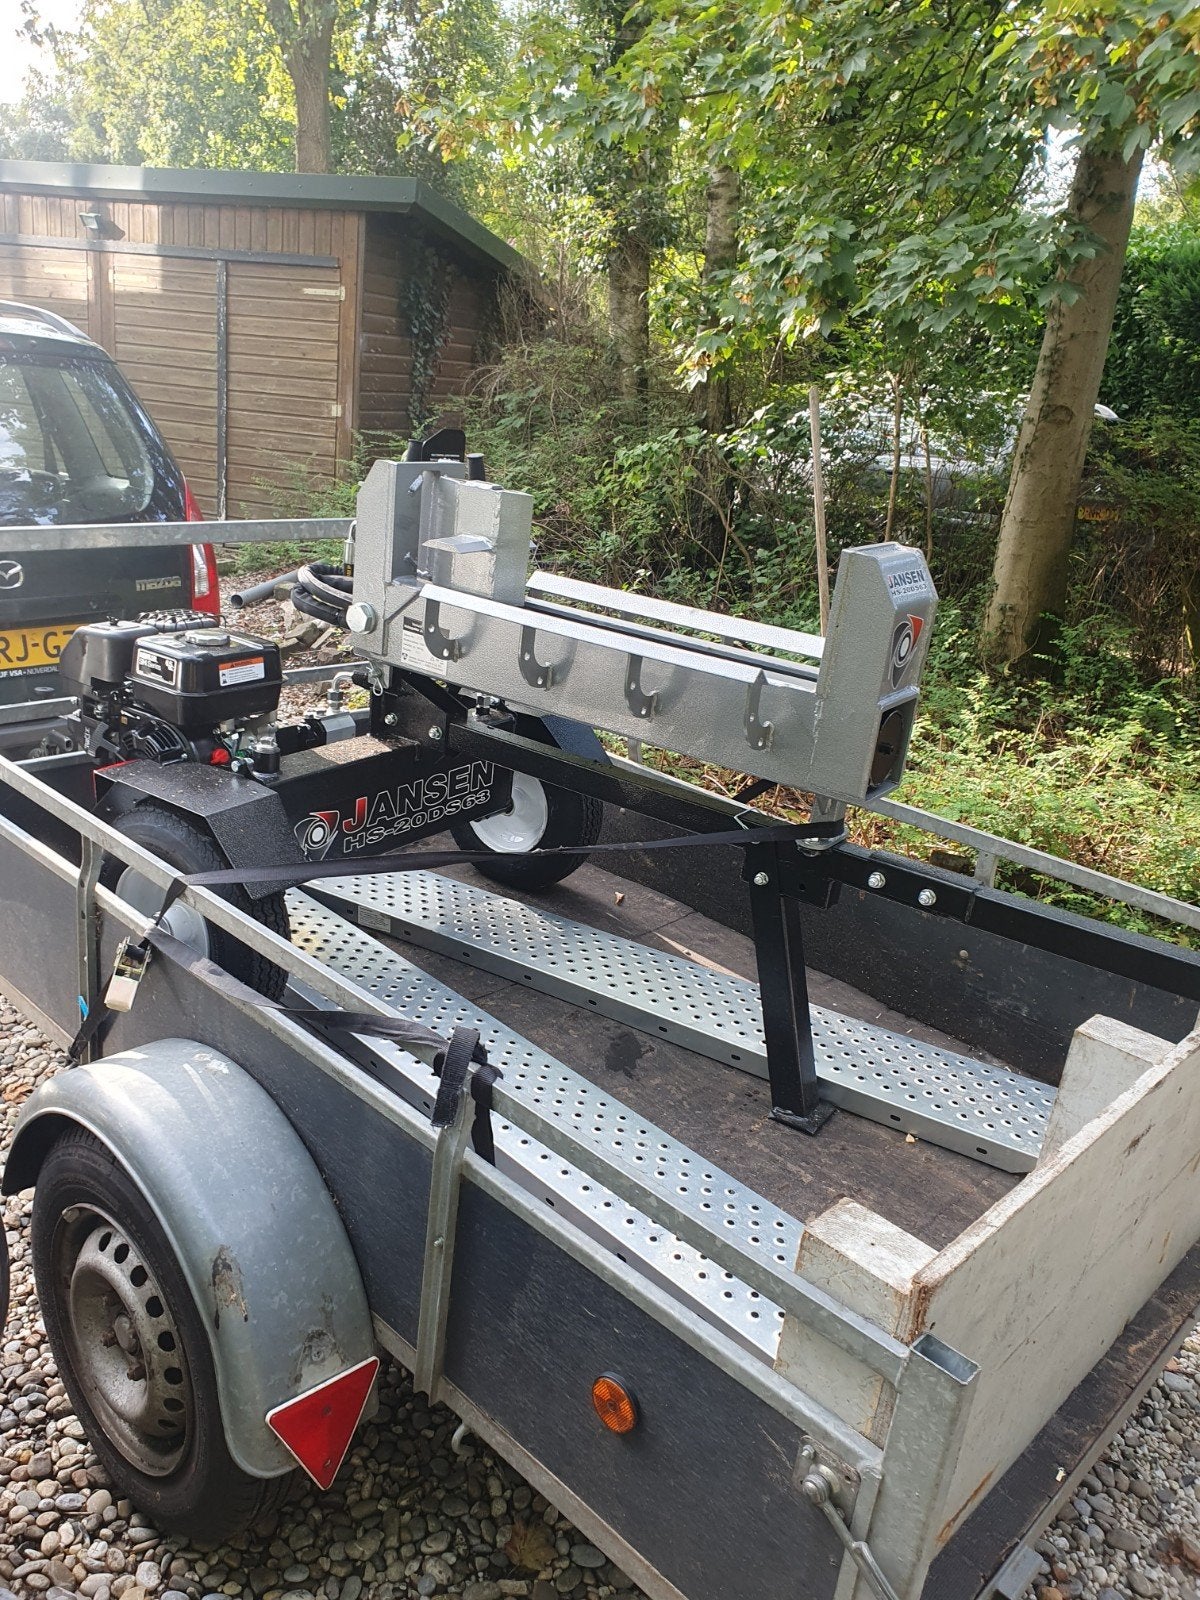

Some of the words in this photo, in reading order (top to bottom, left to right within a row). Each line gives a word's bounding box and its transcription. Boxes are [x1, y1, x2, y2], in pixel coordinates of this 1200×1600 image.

[888, 570, 925, 588] JANSEN
[343, 761, 494, 833] JANSEN
[344, 790, 490, 853] HS-20DS63
